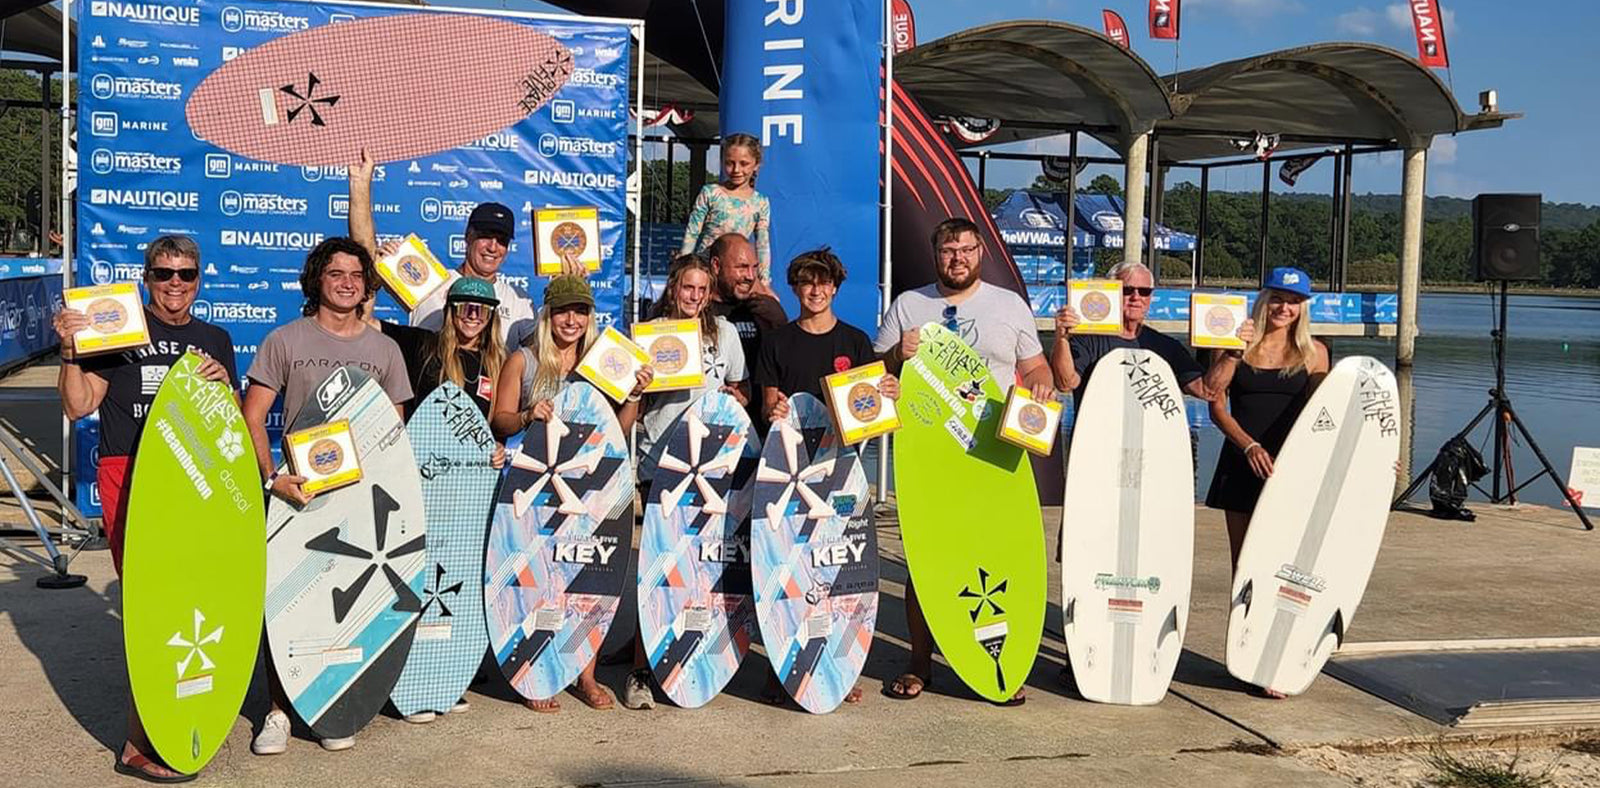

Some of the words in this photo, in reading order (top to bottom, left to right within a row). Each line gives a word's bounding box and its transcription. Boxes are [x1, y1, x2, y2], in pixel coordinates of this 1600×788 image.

[108, 3, 200, 22] NAUTIQUE
[245, 12, 309, 29] masters
[896, 14, 909, 52] IQUE
[115, 80, 182, 95] masters
[555, 105, 571, 118] gm
[578, 108, 616, 118] MARINE
[95, 117, 114, 131] gm
[122, 121, 168, 131] MARINE
[474, 135, 519, 148] IQUE
[559, 138, 616, 153] masters
[115, 154, 182, 170] masters
[209, 159, 226, 172] gm
[235, 163, 279, 173] MARINE
[539, 170, 616, 187] NAUTIQUE
[108, 190, 199, 207] NAUTIQUE
[243, 195, 308, 210] masters
[374, 204, 401, 213] RINE
[1000, 230, 1077, 246] heWWA.co
[497, 273, 529, 288] ters
[589, 280, 613, 289] RINE
[213, 303, 277, 319] masters
[233, 345, 257, 353] MAR
[934, 350, 962, 377] FIVE
[944, 340, 984, 378] PHASE
[1130, 379, 1156, 410] FIVE
[1148, 373, 1181, 420] PHASE
[190, 387, 220, 423] FIVE
[203, 381, 242, 428] PHASE
[1360, 391, 1378, 421] FIVE
[1377, 390, 1398, 438] PHASE
[447, 413, 472, 446] FIVE
[459, 407, 495, 452] PHASE
[220, 469, 253, 513] dorsal
[554, 543, 617, 565] KEY
[700, 541, 751, 563] KEY
[811, 542, 867, 568] KEY
